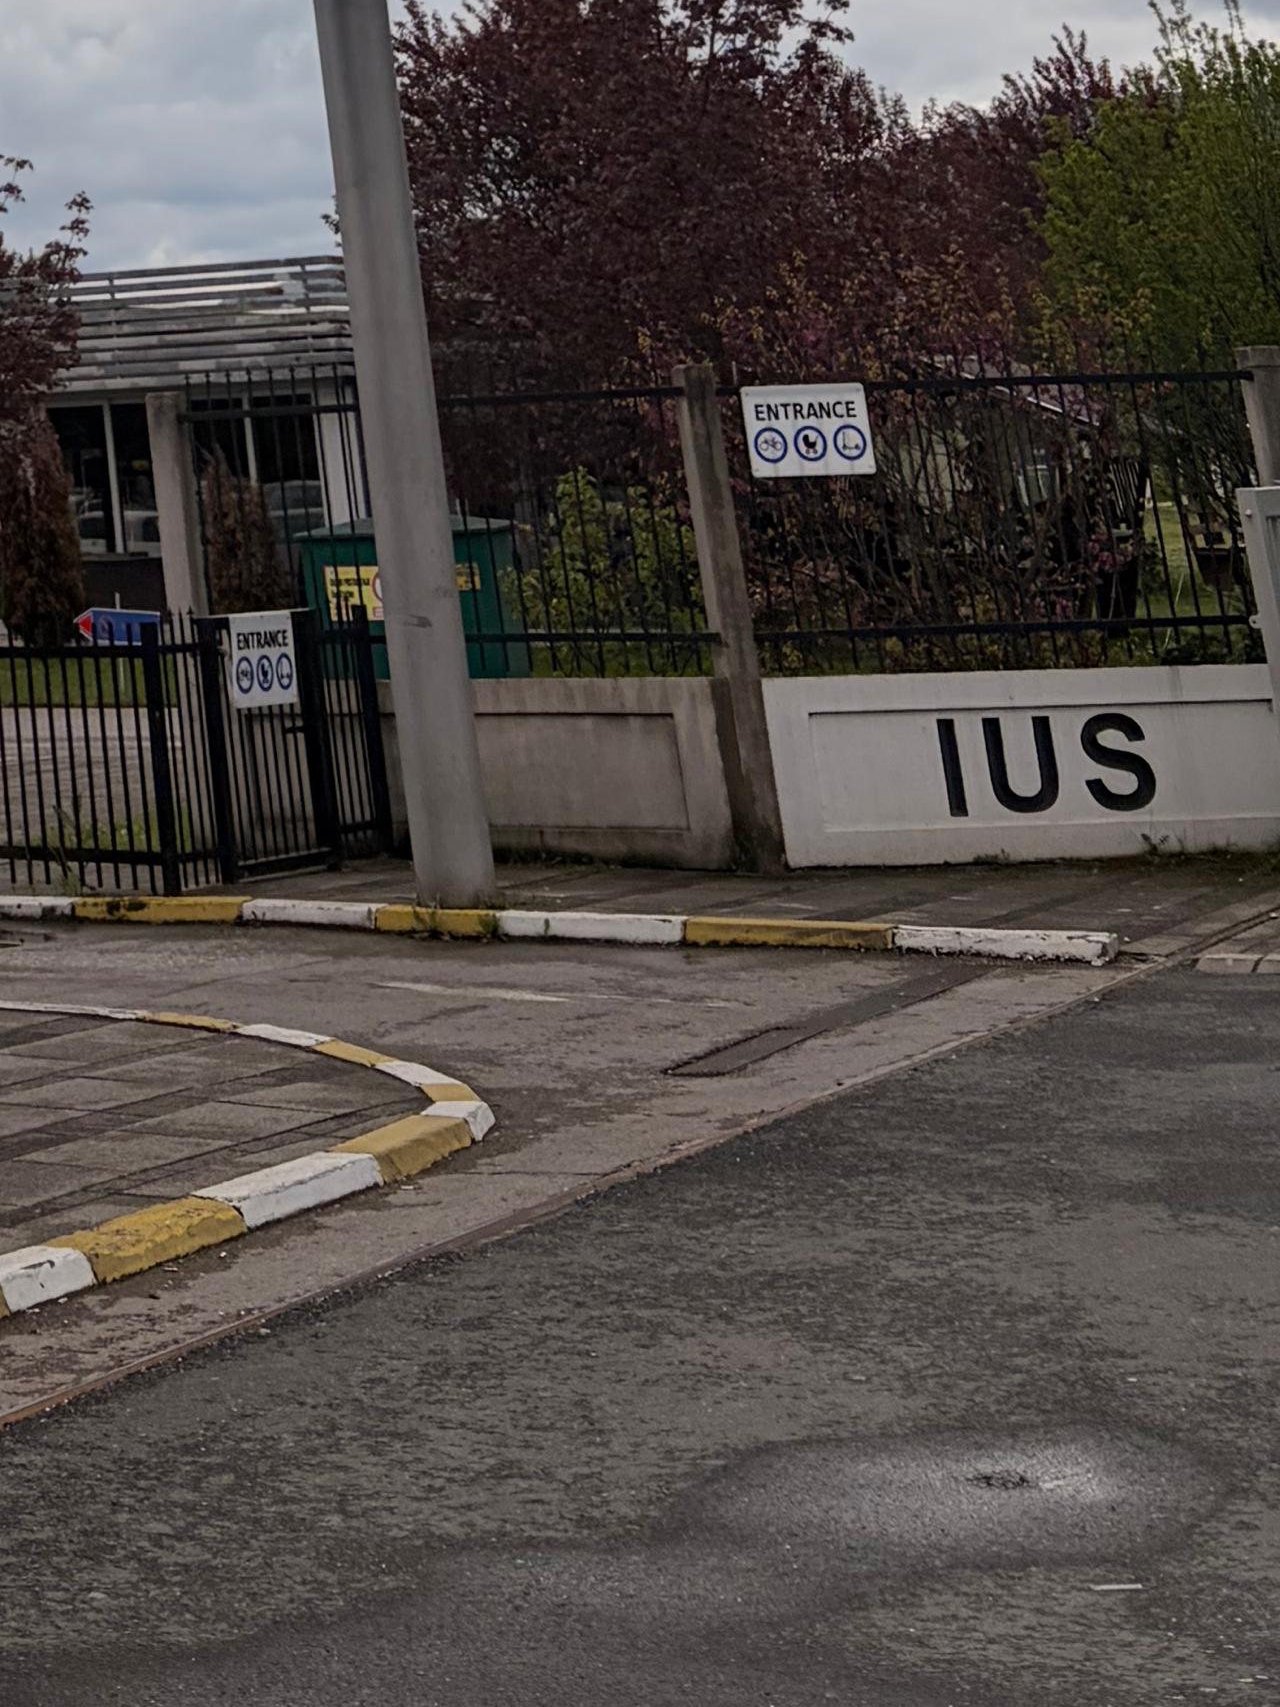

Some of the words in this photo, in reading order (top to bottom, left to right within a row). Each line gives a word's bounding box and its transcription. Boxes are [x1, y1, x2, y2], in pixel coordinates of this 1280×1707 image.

[753, 399, 858, 422] ENTRANCE
[236, 629, 289, 651] ENTRANCE
[936, 711, 1158, 818] IUS
